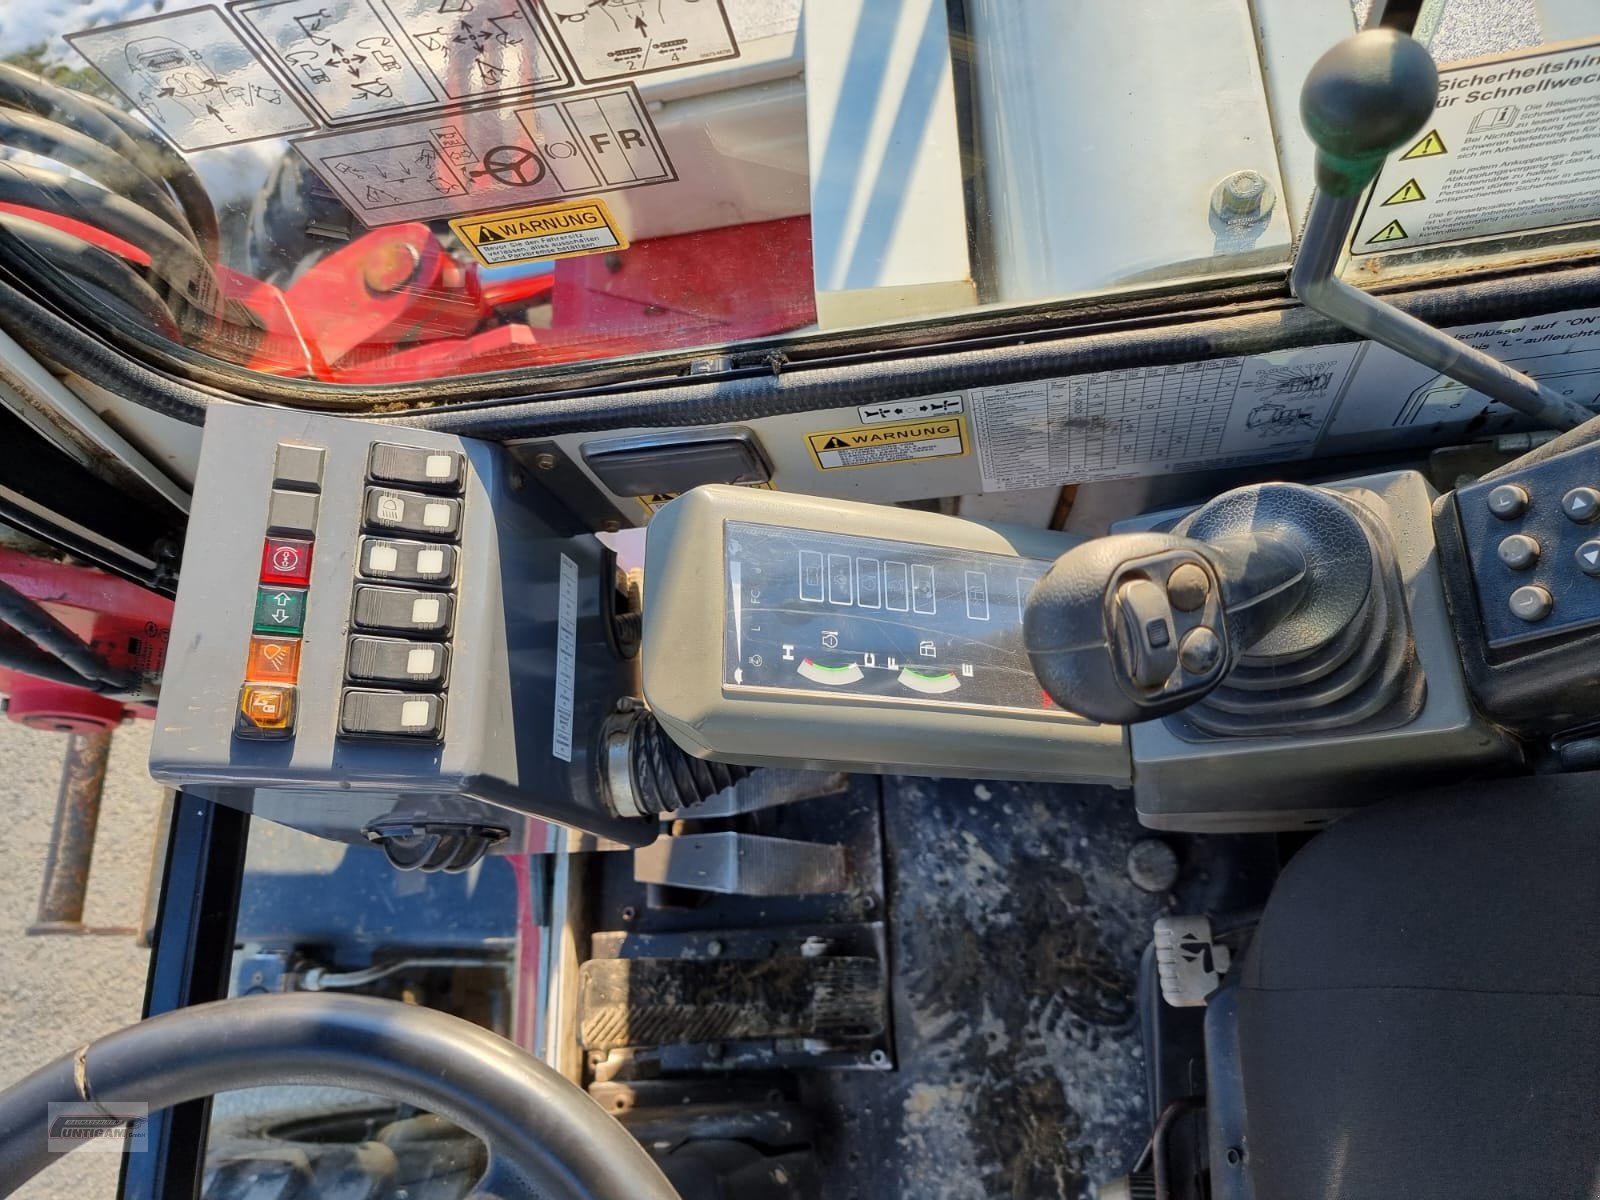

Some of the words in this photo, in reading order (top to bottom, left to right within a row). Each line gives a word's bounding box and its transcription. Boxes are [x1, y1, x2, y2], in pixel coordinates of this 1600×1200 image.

[626, 60, 637, 71] 2
[590, 133, 611, 154] F
[619, 128, 646, 150] R
[498, 212, 598, 237] WARNUNG
[1531, 320, 1560, 331] auf
[852, 426, 952, 444] WARNUNG
[782, 643, 795, 661] H
[888, 656, 900, 671] F
[962, 663, 974, 677] E
